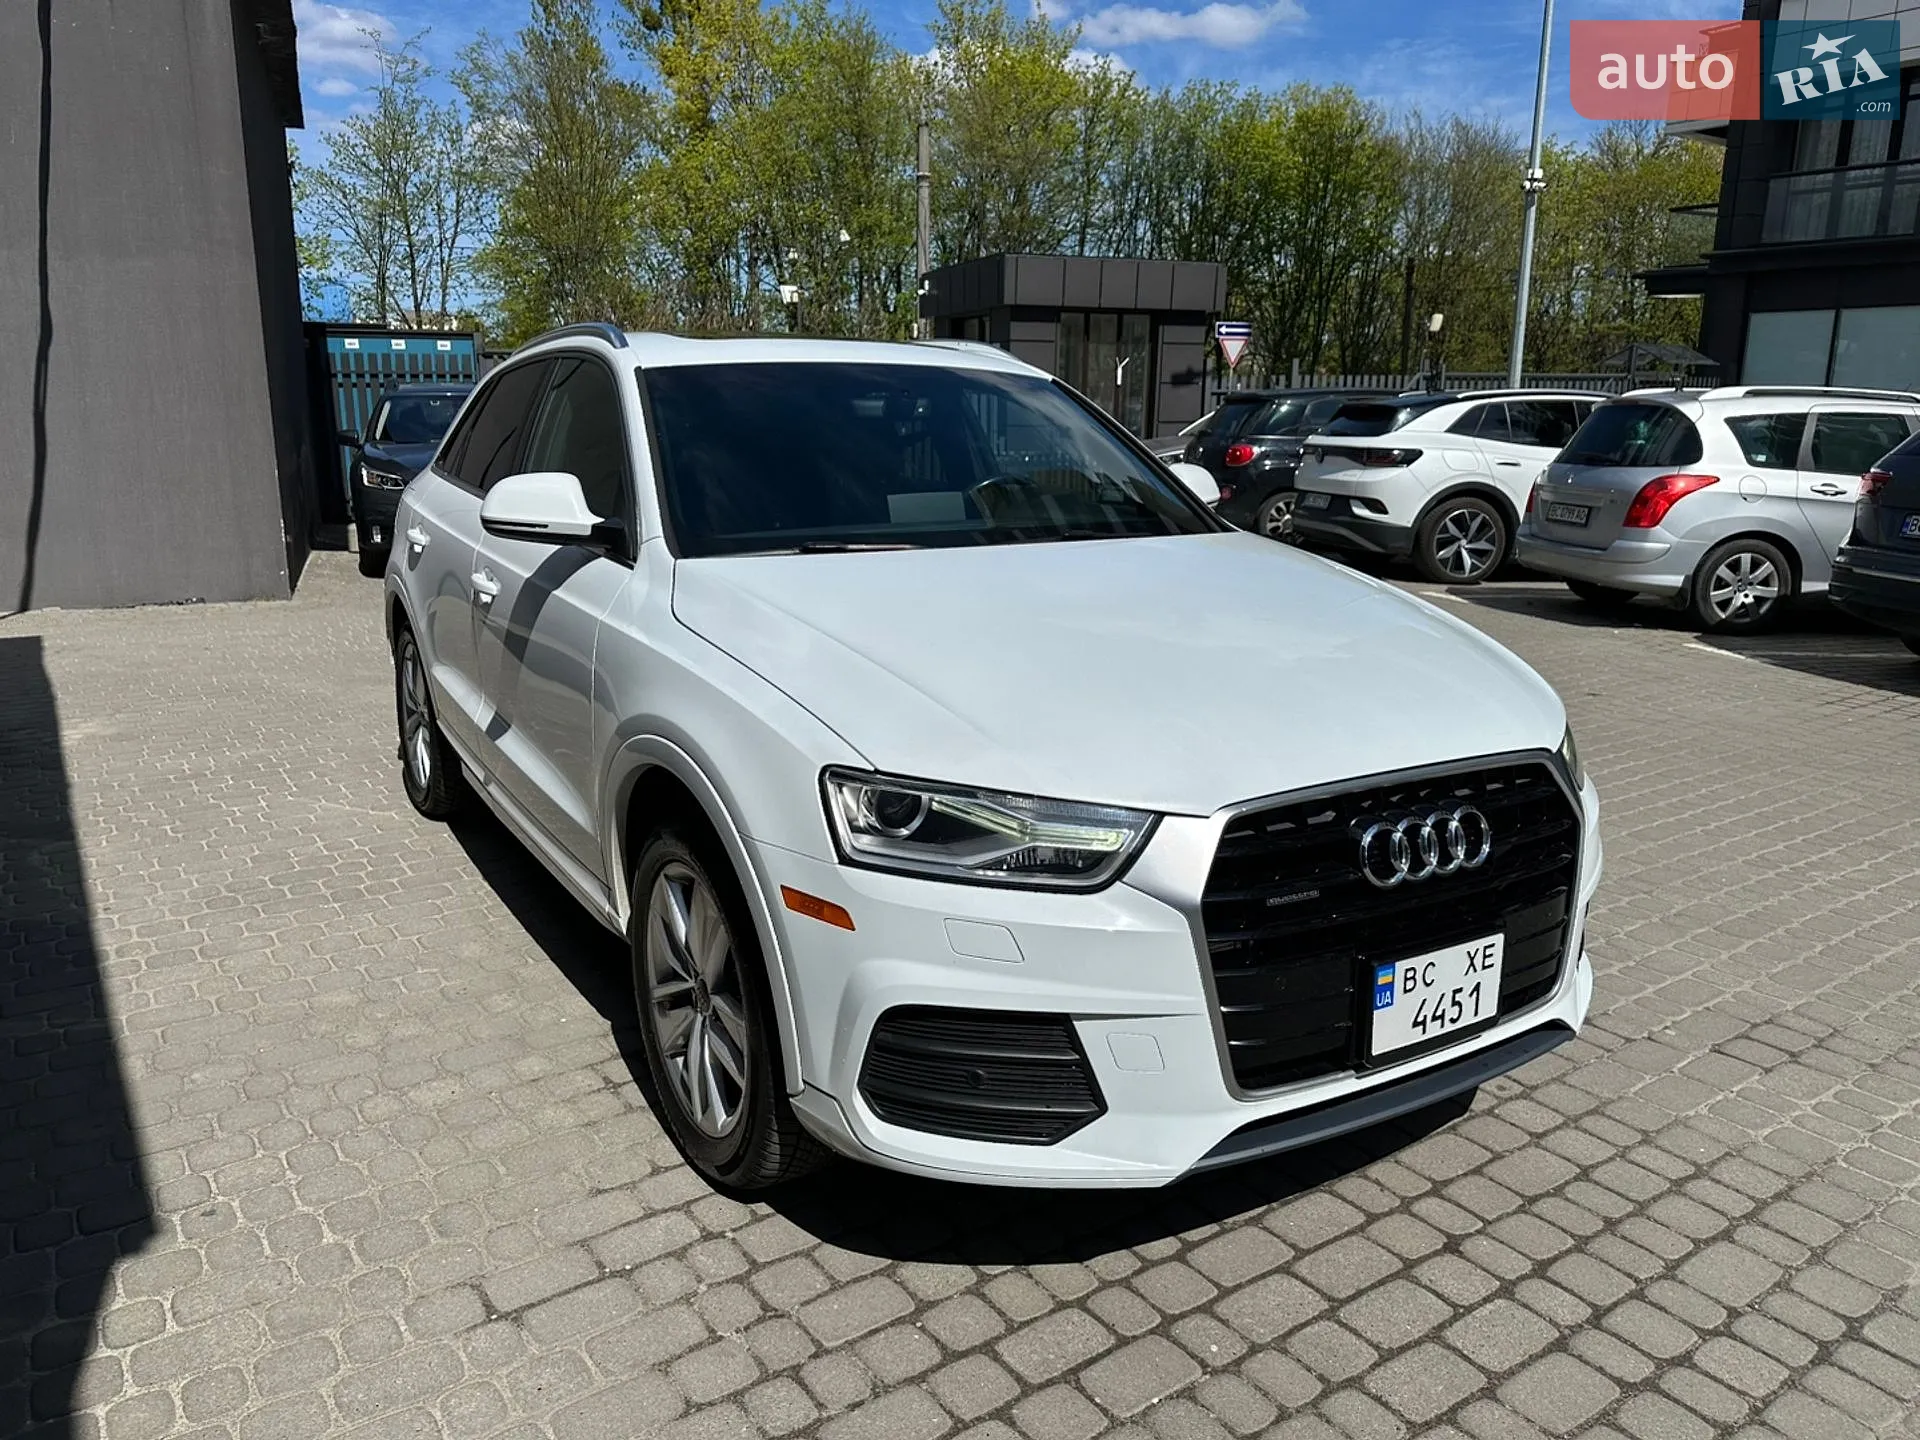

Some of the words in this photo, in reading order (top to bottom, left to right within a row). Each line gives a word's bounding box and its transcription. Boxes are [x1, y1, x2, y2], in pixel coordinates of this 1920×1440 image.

[1403, 961, 1436, 995] BC
[1464, 942, 1496, 976] XE
[1376, 991, 1392, 1007] UA
[1411, 981, 1481, 1035] 4451
